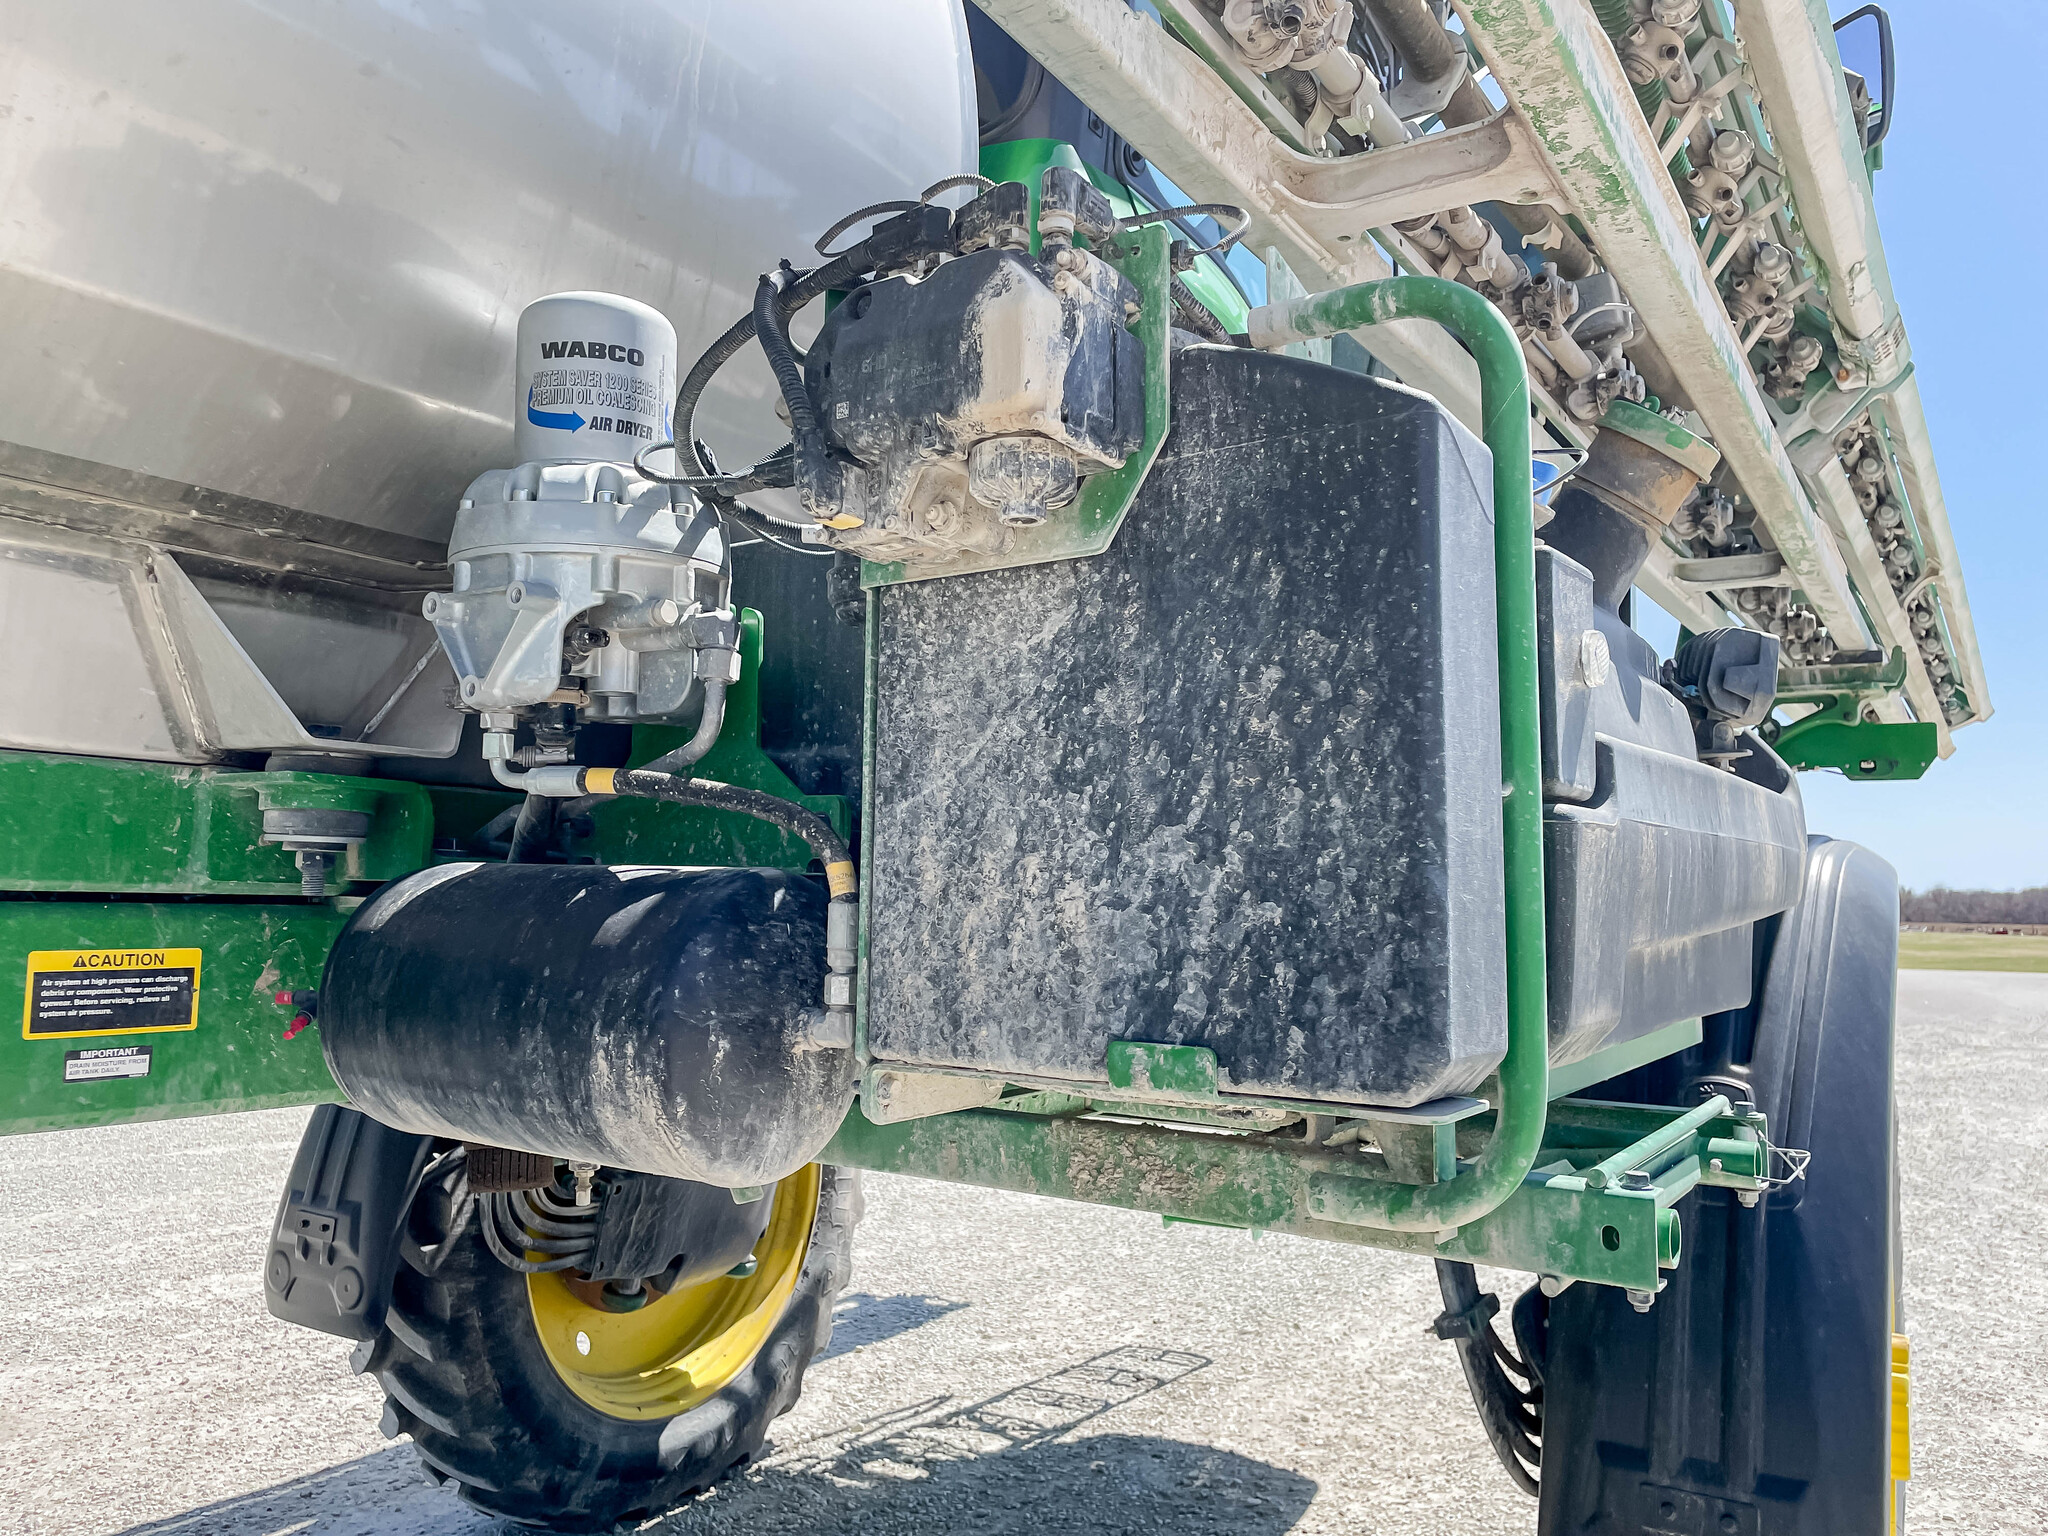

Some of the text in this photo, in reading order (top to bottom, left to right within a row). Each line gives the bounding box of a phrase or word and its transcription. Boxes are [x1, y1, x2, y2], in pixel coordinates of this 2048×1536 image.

[540, 341, 645, 367] WABCO
[533, 370, 657, 400] SYSTEM SAVER 1200 SERIES
[531, 387, 657, 418] PREMIUM OIL COALESCING
[589, 416, 653, 441] AIR DRYER
[88, 953, 165, 968] CAUTION
[42, 979, 53, 987] Air
[54, 979, 81, 987] system
[91, 977, 108, 986] high
[108, 977, 140, 986] pressure
[155, 975, 188, 984] discharge
[41, 989, 65, 997] debris
[76, 988, 124, 997] components.
[124, 986, 142, 994] Wear
[143, 985, 178, 994] protective
[39, 994, 170, 1009] eyewear. Before servicing, relieve all
[39, 1010, 66, 1019] system
[78, 1008, 113, 1017] pressure.
[80, 1047, 139, 1059] IMPORTANT
